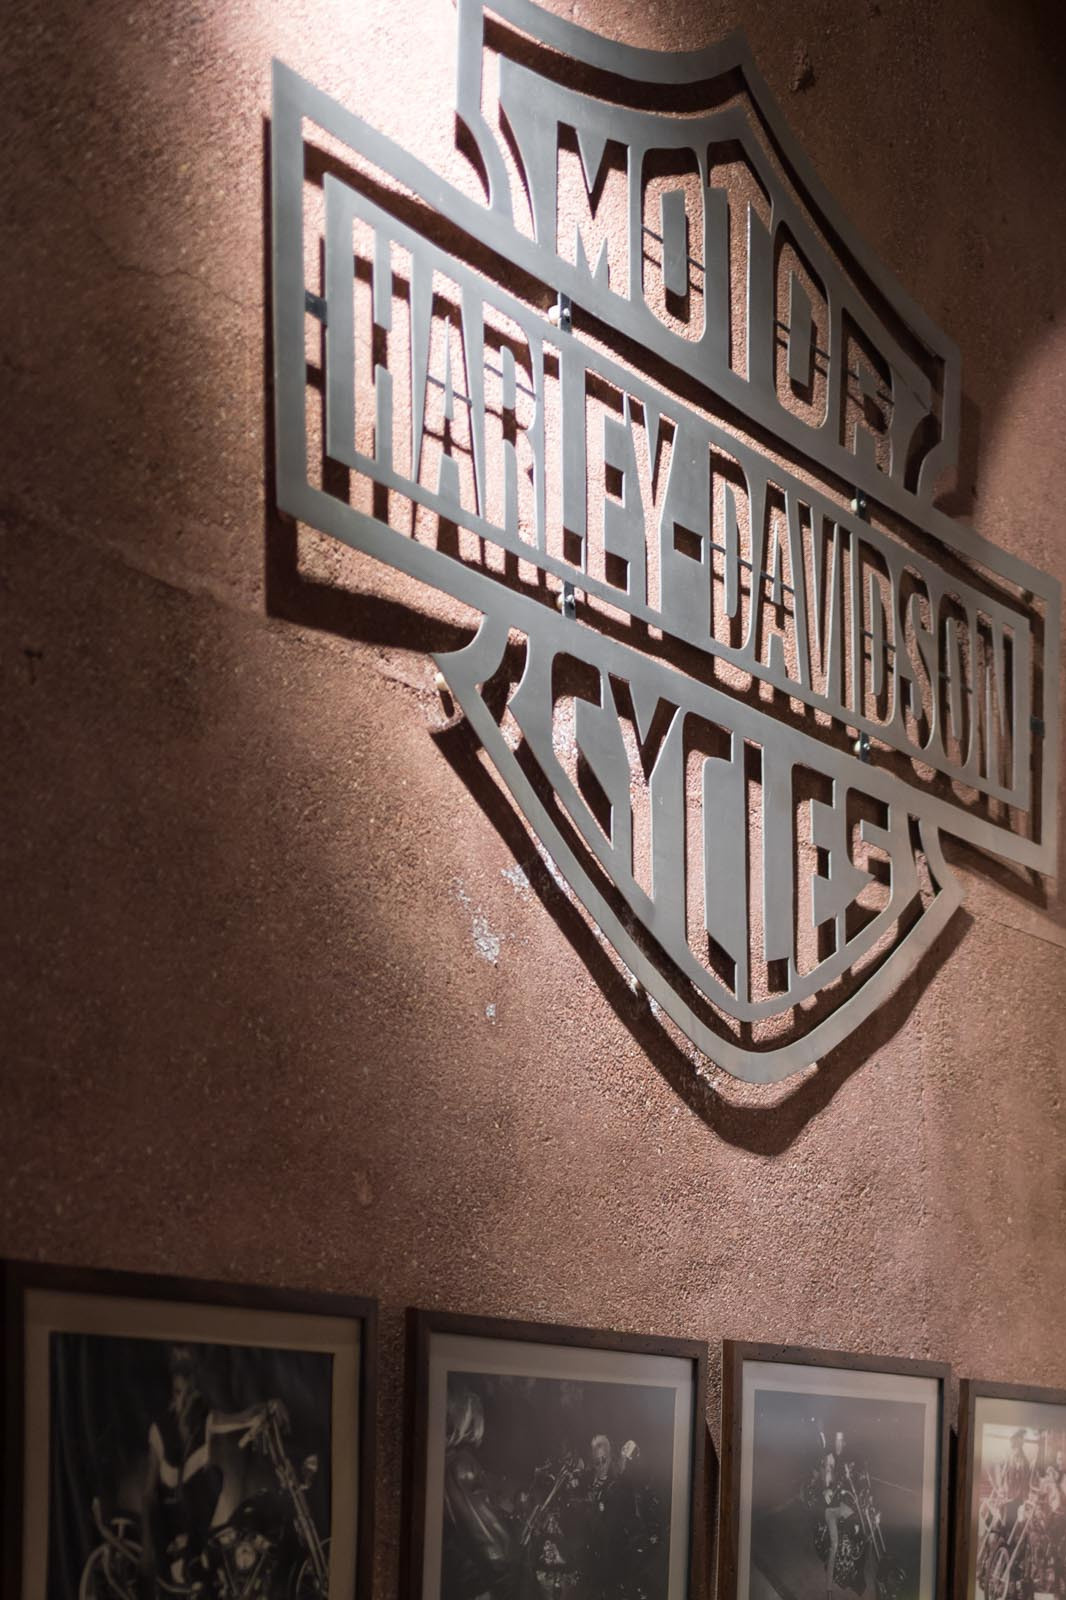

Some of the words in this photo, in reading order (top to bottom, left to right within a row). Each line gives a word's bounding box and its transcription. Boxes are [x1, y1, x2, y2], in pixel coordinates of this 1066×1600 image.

[556, 120, 894, 480] MOTOR
[352, 214, 1016, 792] HARLEY-DAVIDSON
[550, 650, 894, 1004] CYCLES
